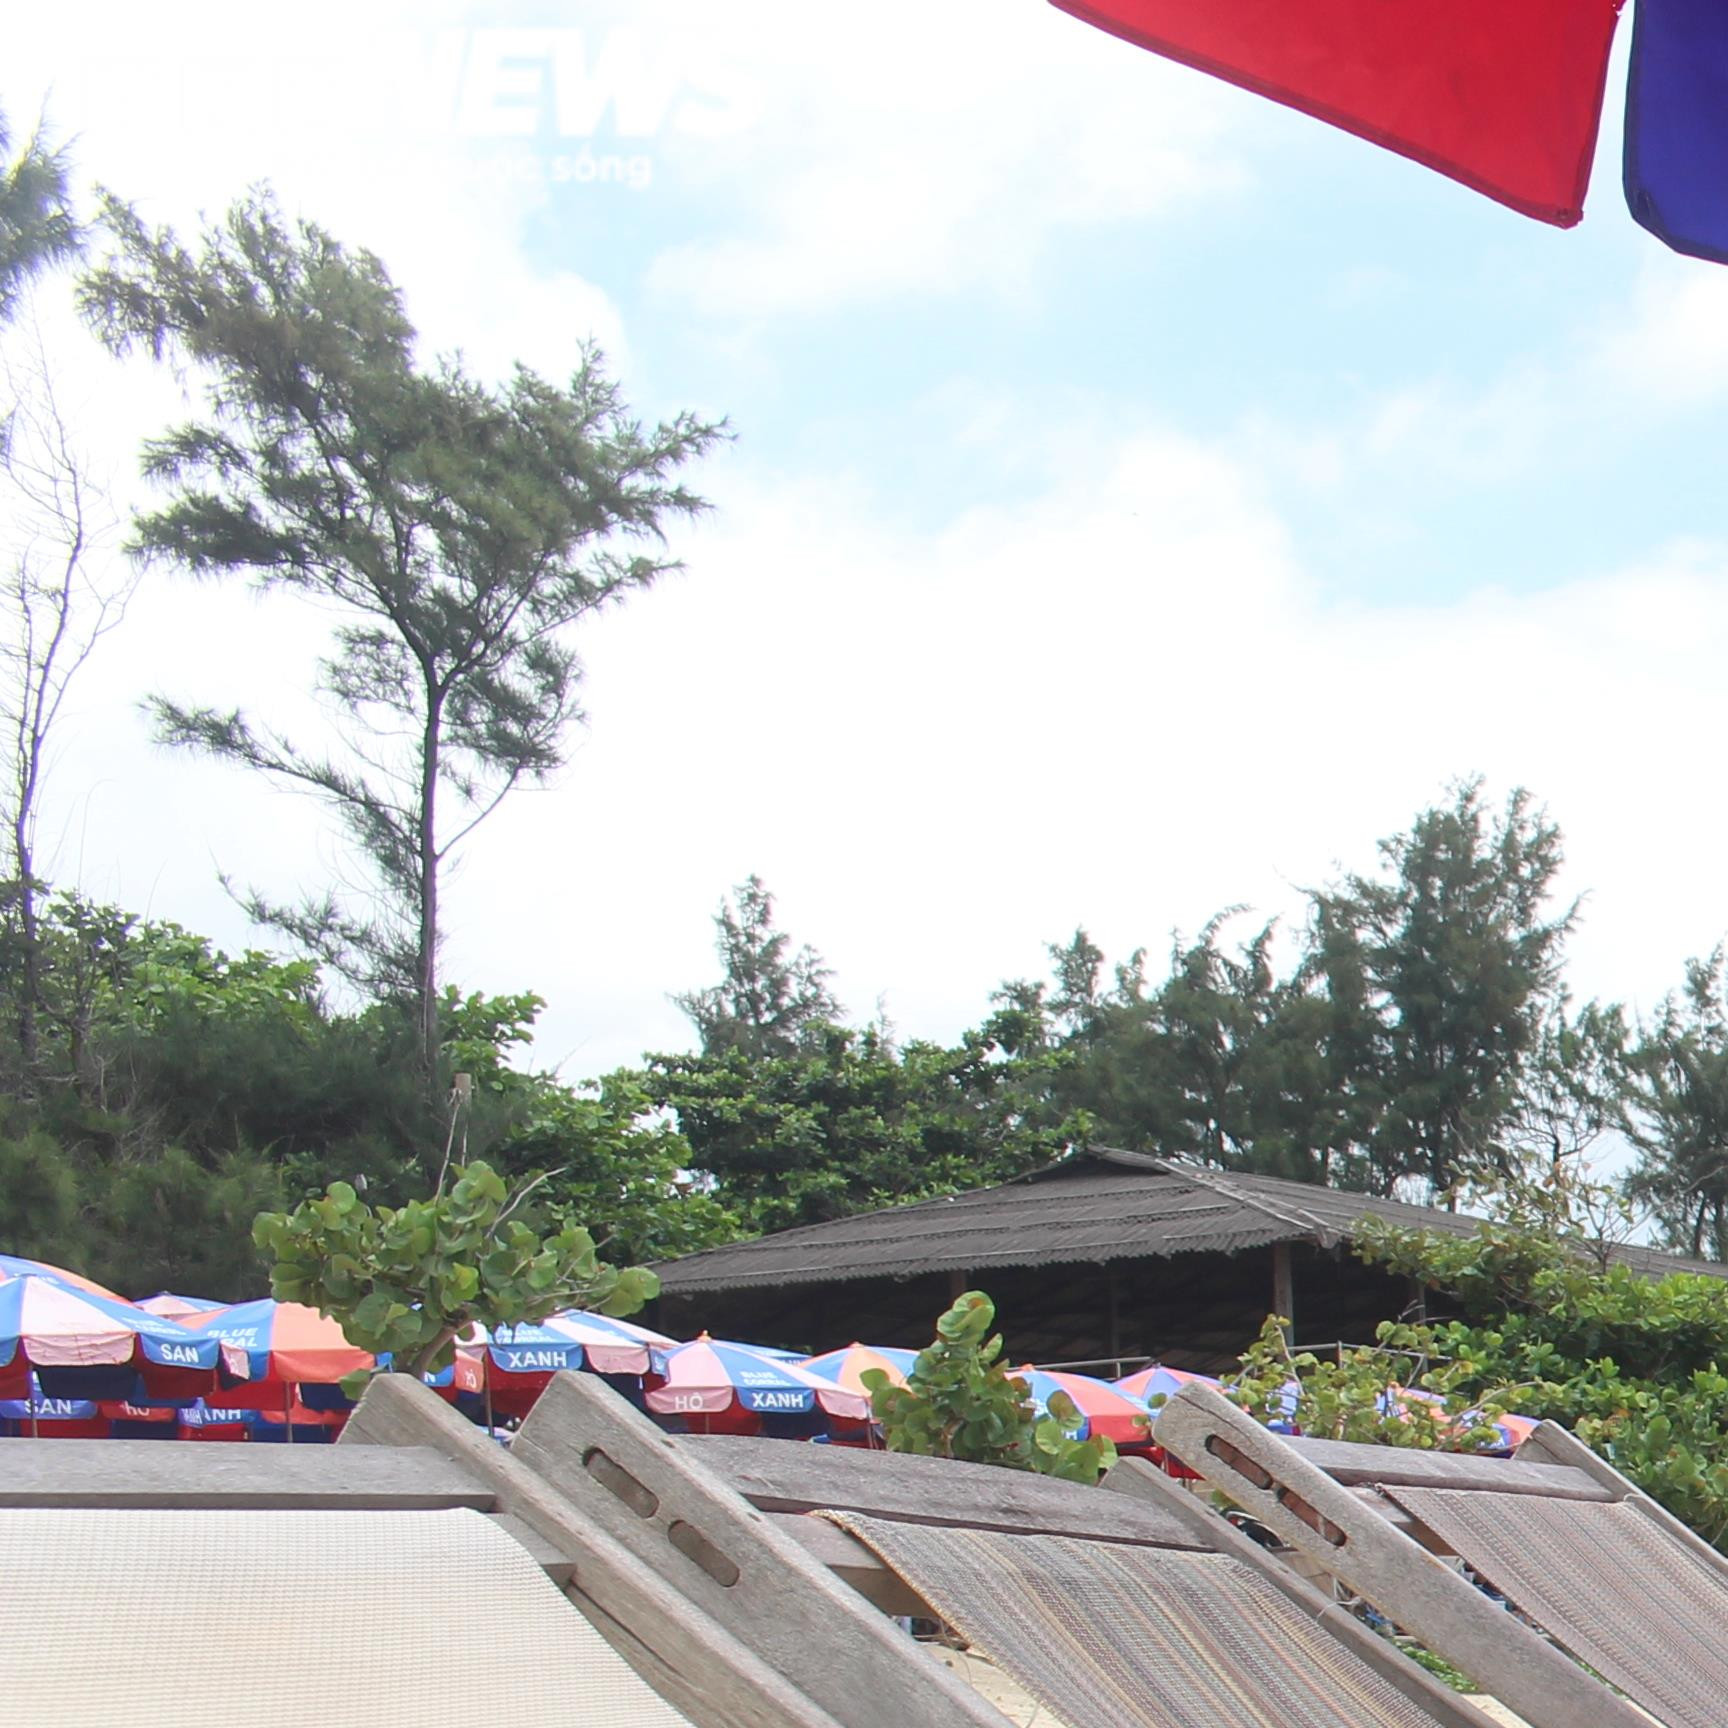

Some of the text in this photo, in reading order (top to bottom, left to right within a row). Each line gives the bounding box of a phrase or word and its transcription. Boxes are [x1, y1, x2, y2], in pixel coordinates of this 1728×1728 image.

[160, 1342, 199, 1364] SAN
[509, 1350, 567, 1369] XANH
[675, 1392, 704, 1410] HÔ
[752, 1391, 804, 1409] XANH
